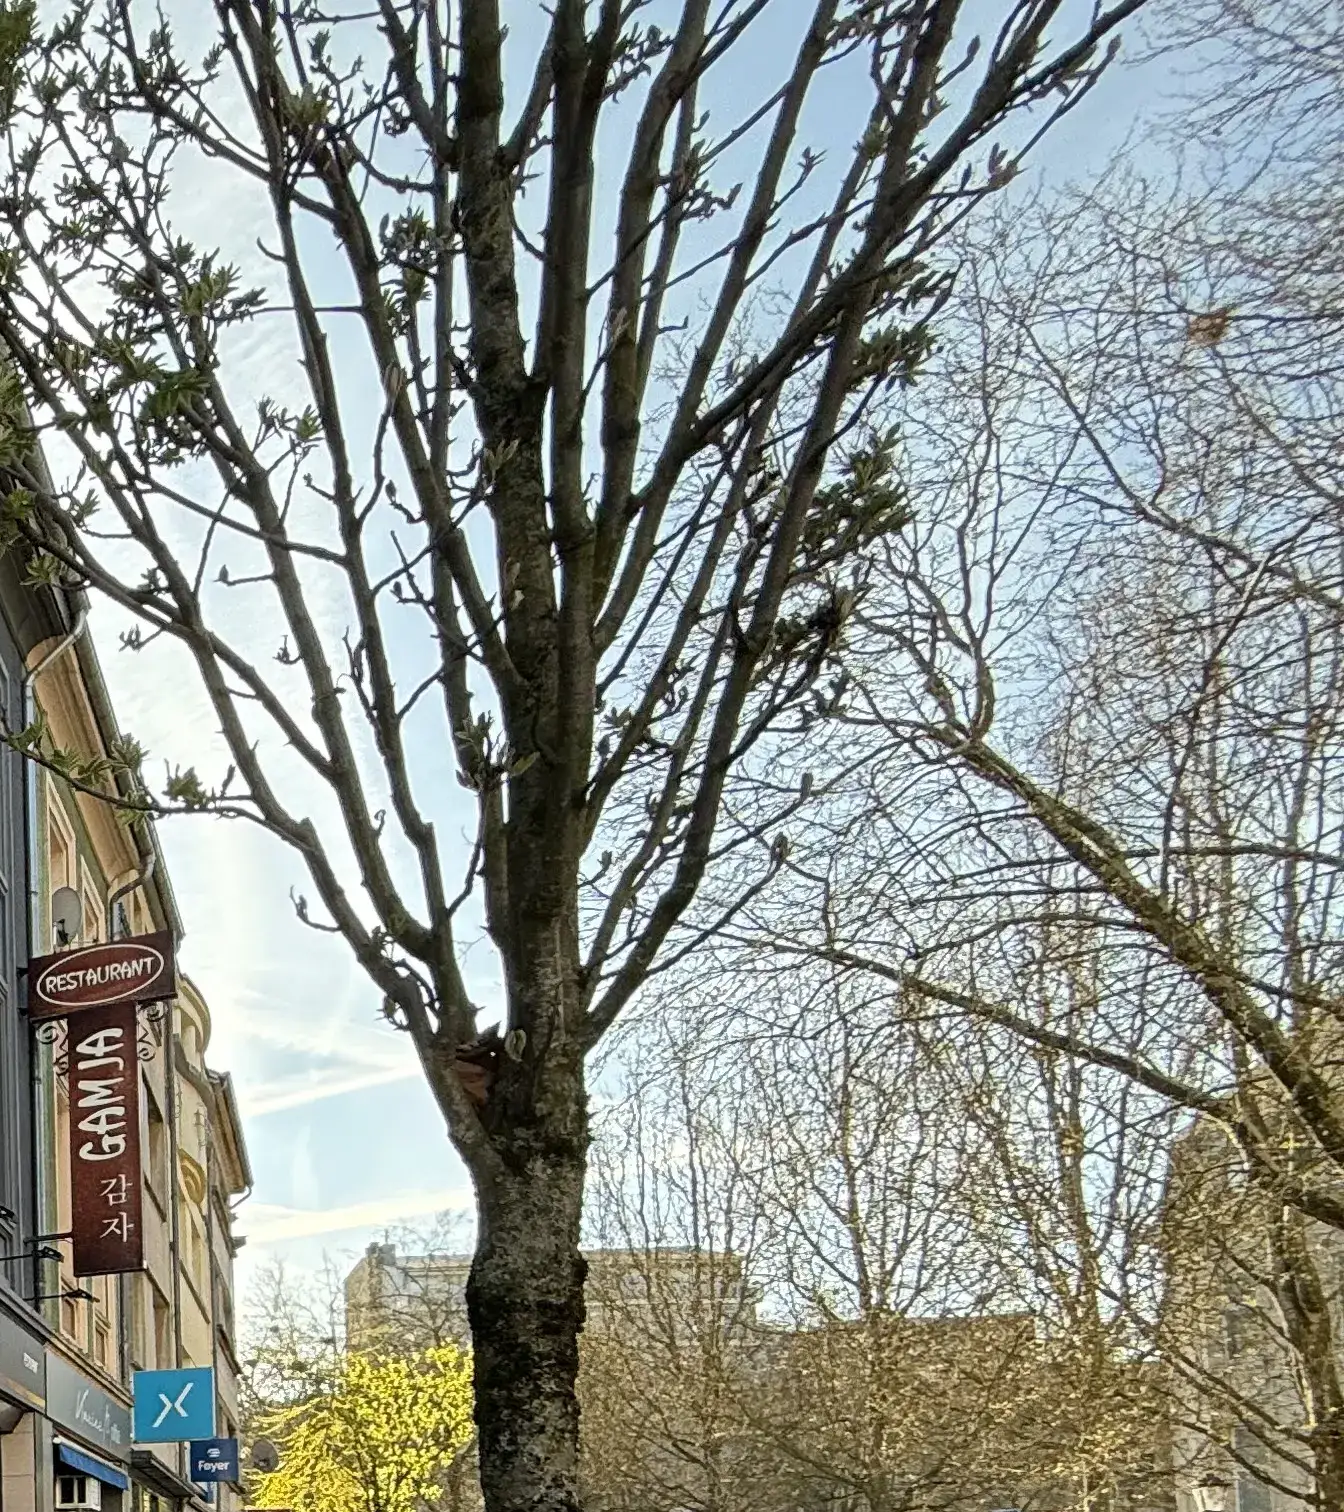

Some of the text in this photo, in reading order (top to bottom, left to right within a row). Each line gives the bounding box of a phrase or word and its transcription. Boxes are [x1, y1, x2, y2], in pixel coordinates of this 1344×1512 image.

[46, 957, 155, 994] RESTAURANT
[76, 1027, 127, 1161] GAMJA
[99, 1174, 134, 1242] 감자
[198, 1460, 230, 1472] Foyer
